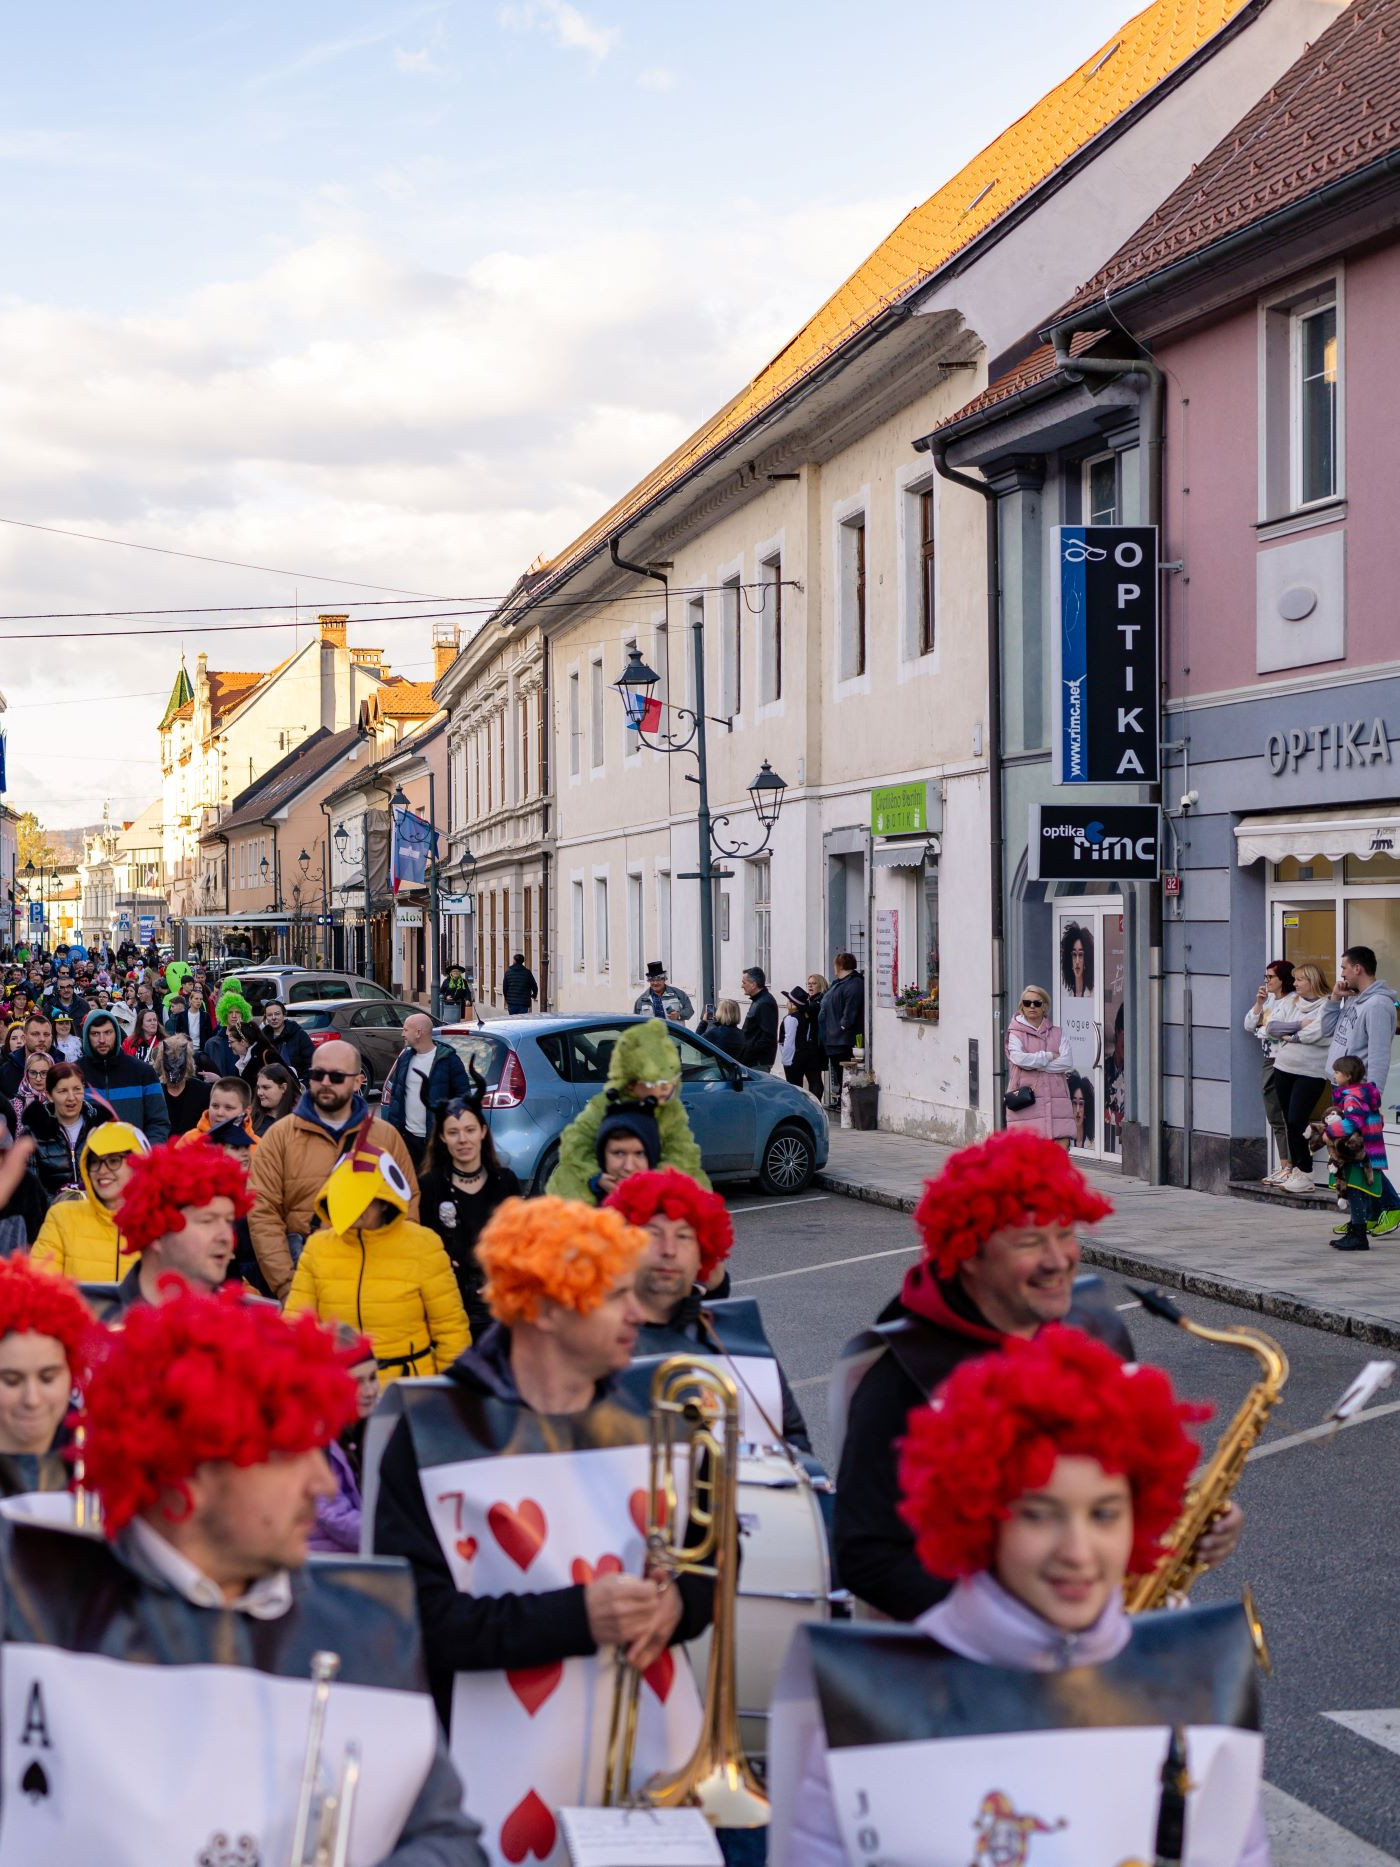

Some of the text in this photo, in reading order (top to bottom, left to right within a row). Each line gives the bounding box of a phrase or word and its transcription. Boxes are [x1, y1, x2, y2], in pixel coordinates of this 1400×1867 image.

[1114, 542, 1145, 775] OPTIKA
[1068, 680, 1081, 777] www.rimc.net
[1265, 717, 1392, 776] OPTIKA
[1042, 825, 1085, 839] optika
[33, 904, 40, 913] P
[1167, 878, 1177, 889] 32
[1066, 1019, 1089, 1032] vogue
[436, 1490, 465, 1532] 7
[20, 1679, 53, 1748] A
[853, 1787, 880, 1867] JO
